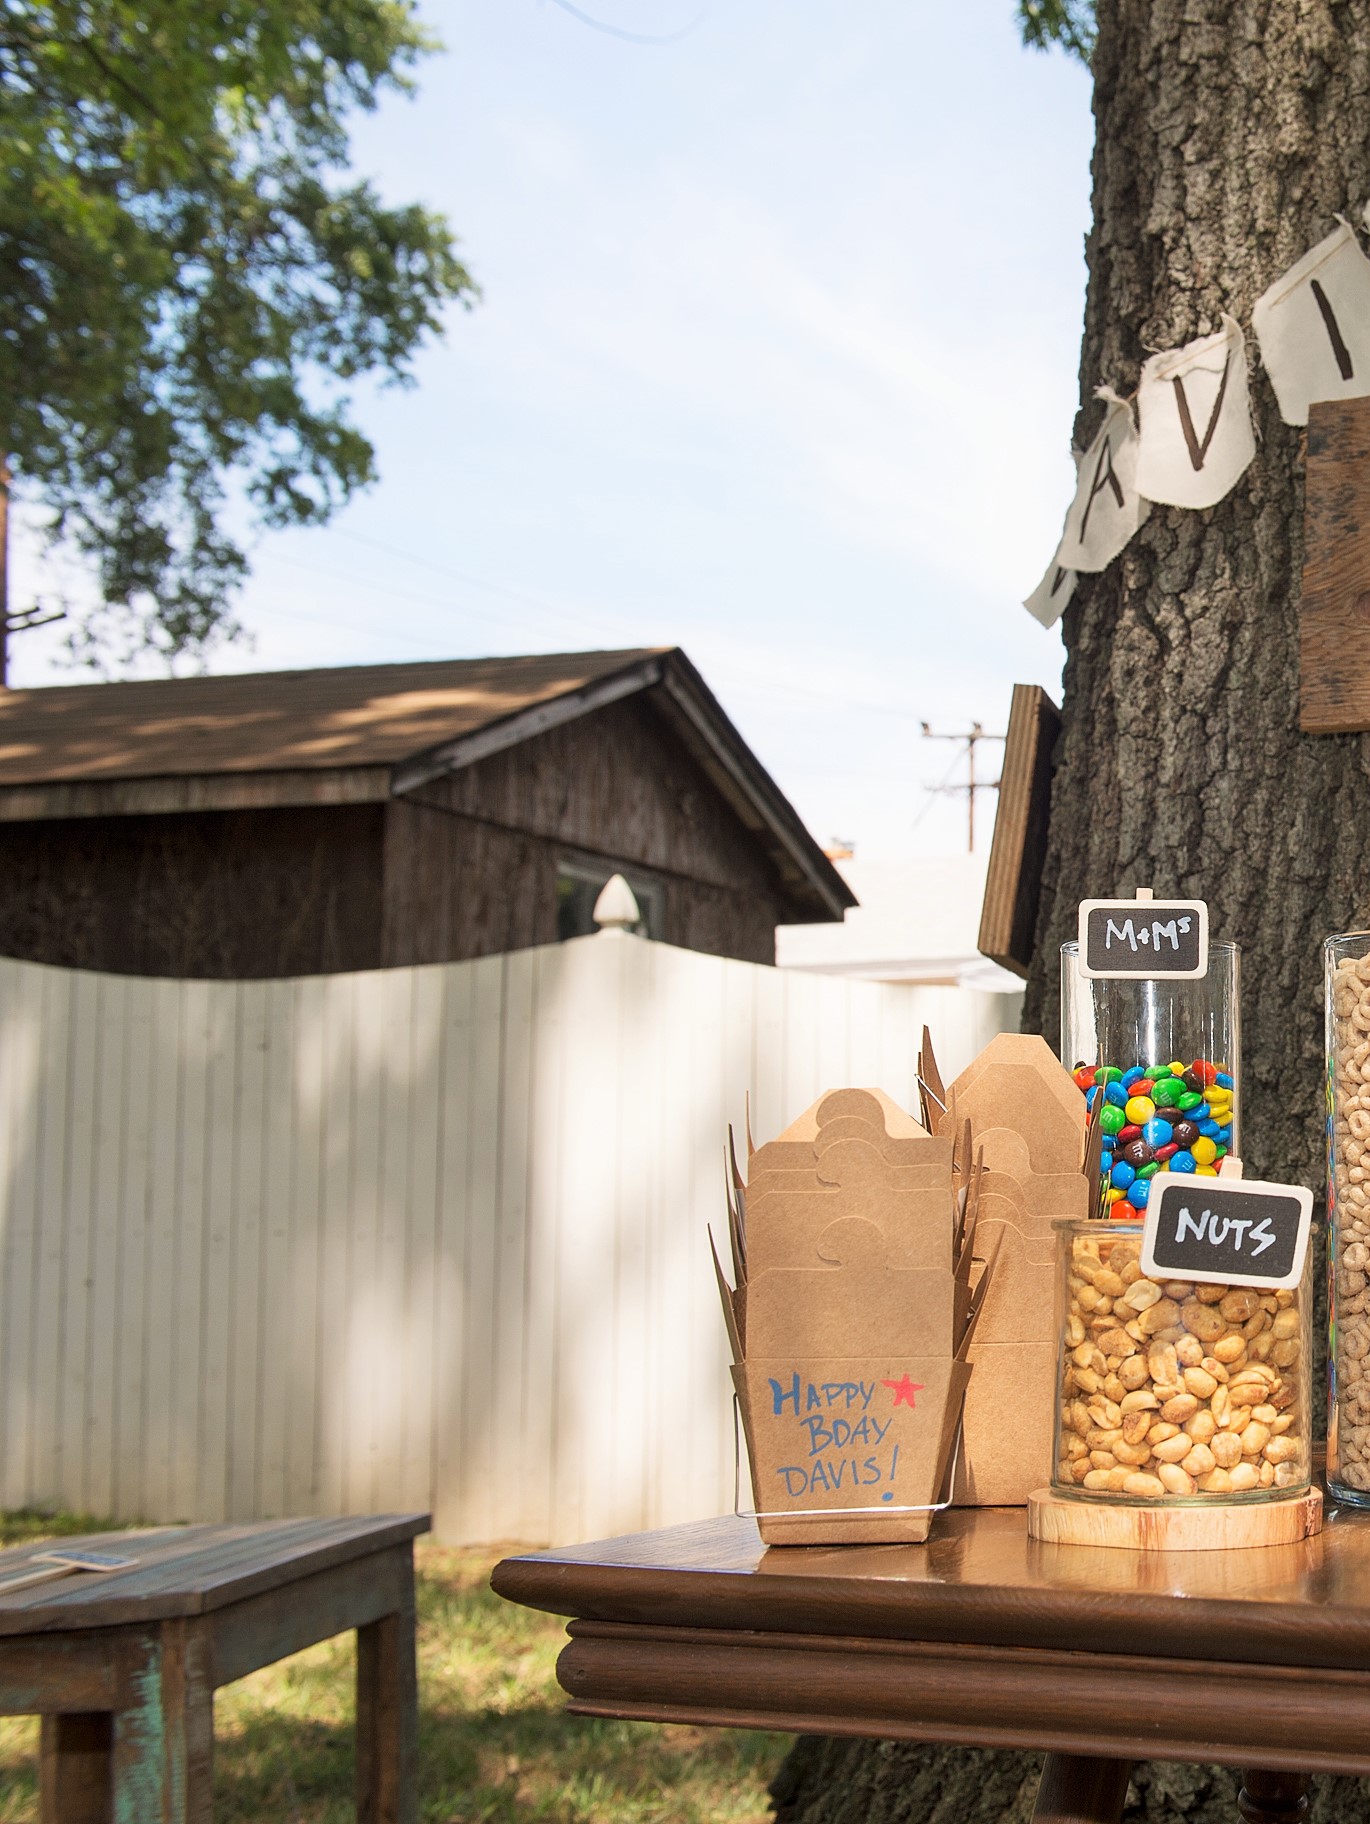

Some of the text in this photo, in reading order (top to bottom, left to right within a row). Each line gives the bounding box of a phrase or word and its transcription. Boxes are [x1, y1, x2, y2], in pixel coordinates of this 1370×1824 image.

[1174, 1207, 1277, 1257] NUTS
[768, 1371, 876, 1416] HAPPY
[800, 1414, 893, 1457] BDAY
[777, 1444, 899, 1502] DAVIS!
